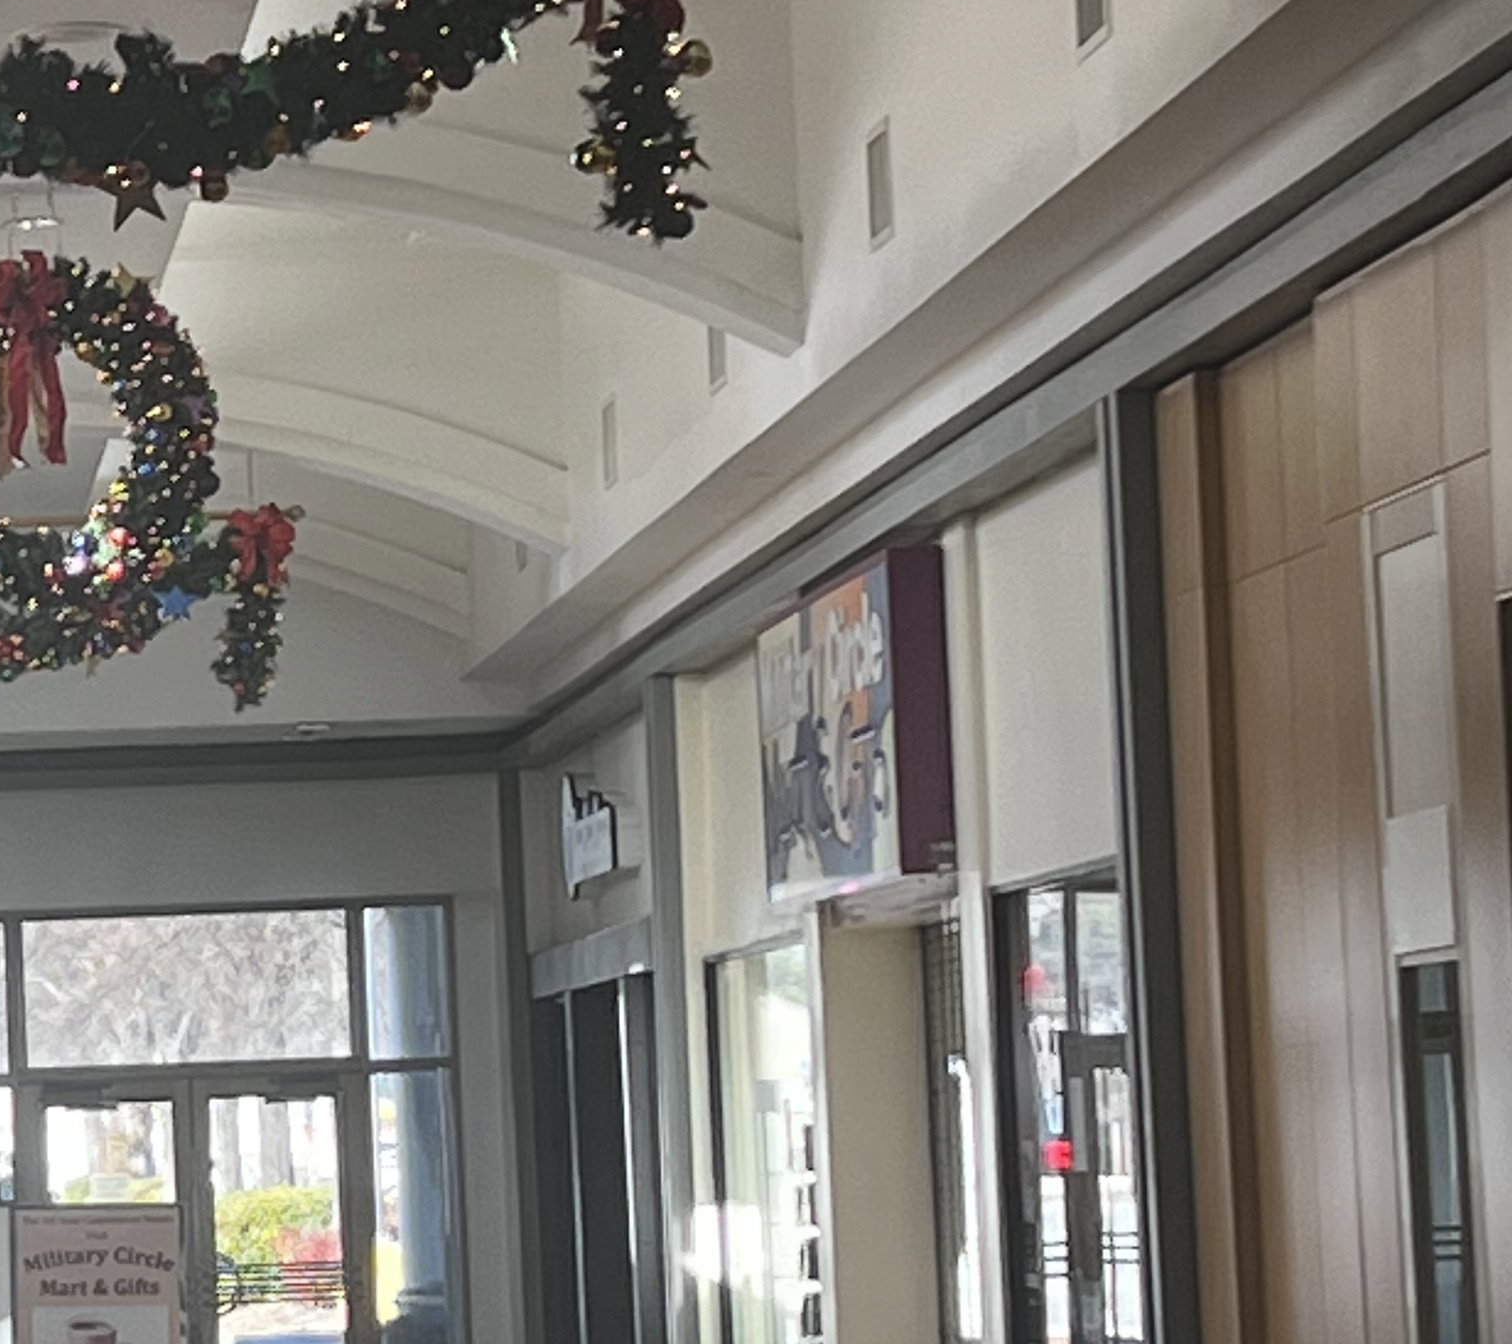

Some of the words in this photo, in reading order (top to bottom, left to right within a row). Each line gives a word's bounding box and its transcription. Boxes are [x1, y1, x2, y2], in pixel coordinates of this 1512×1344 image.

[23, 1248, 109, 1272] Military
[113, 1246, 175, 1271] Circle
[40, 1278, 87, 1296] Mart
[93, 1278, 108, 1295] &
[114, 1278, 160, 1296] Gifts
